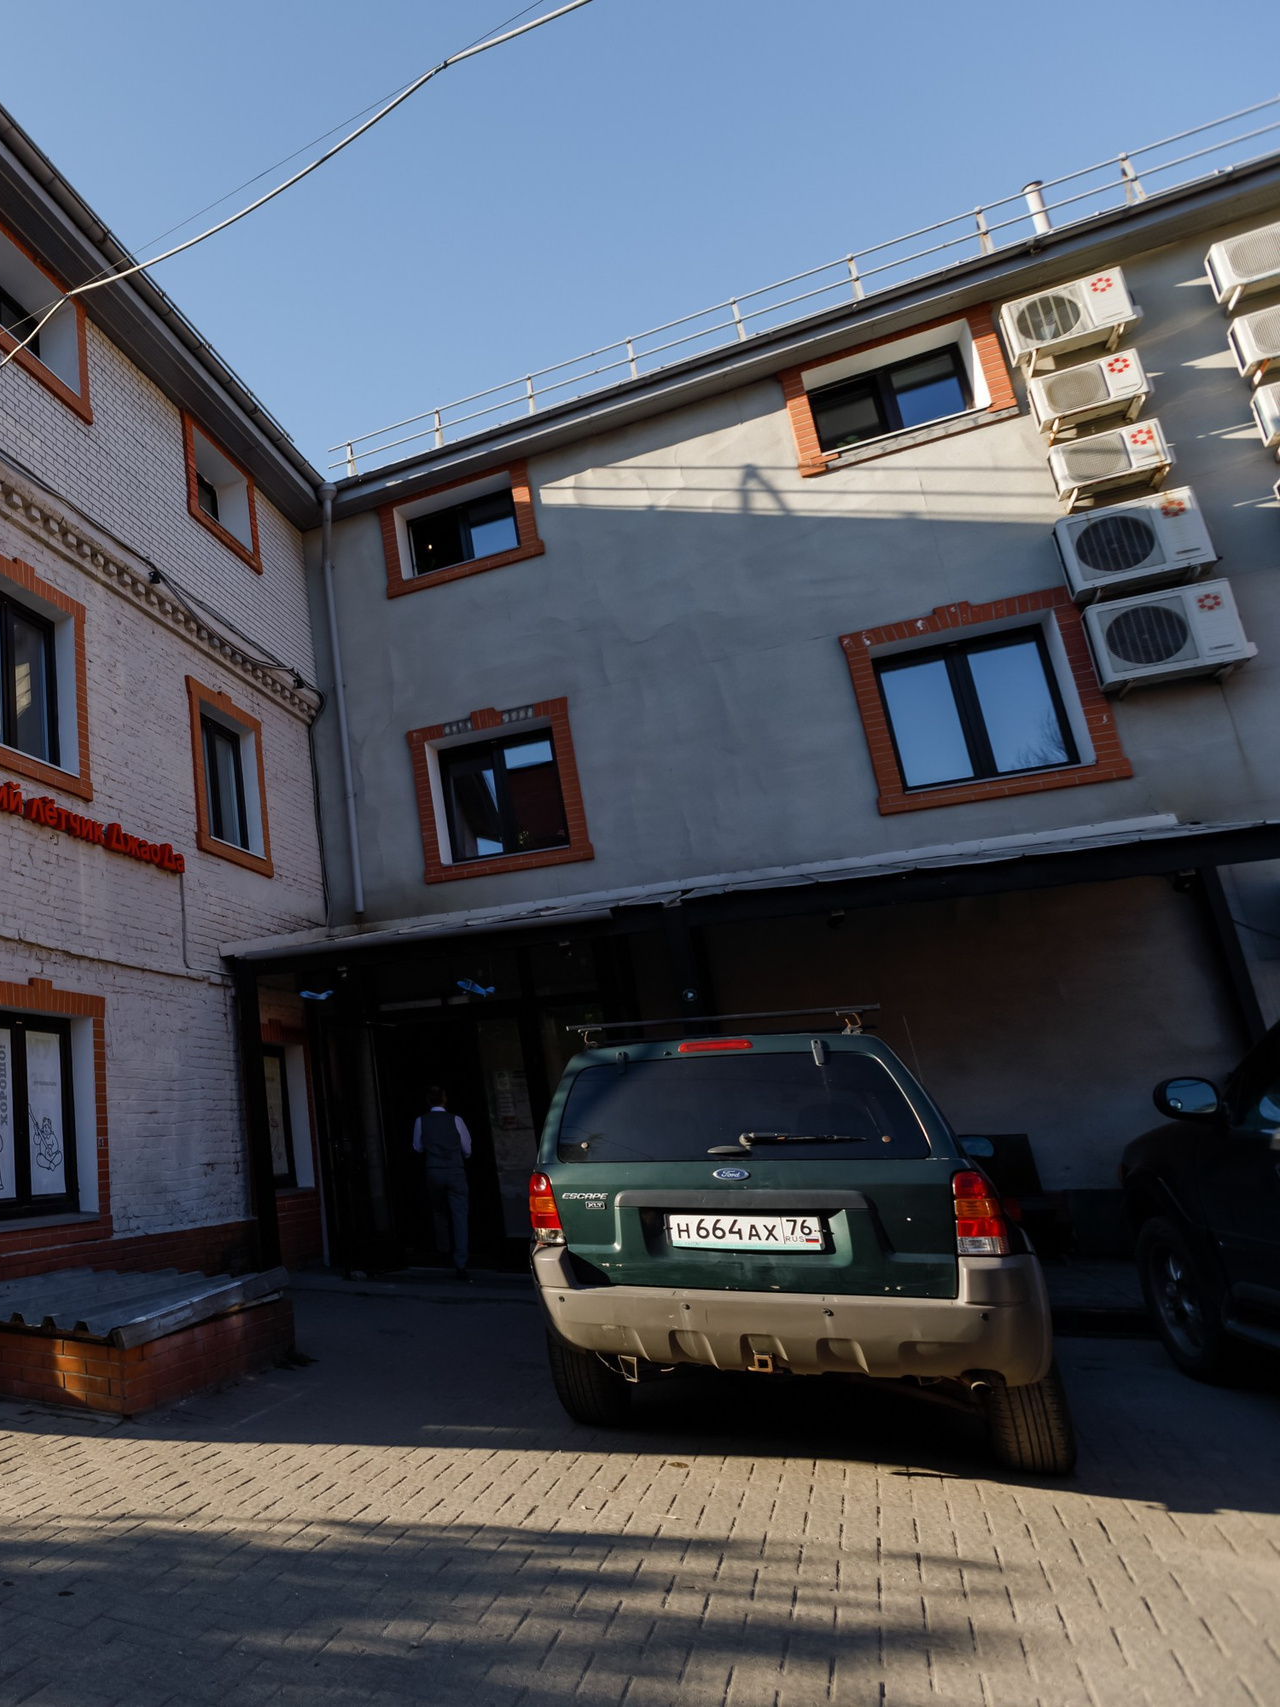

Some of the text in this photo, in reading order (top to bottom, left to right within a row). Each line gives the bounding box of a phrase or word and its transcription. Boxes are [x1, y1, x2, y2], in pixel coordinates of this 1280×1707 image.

[561, 1192, 609, 1200] ESCAPE
[785, 1218, 813, 1236] 76
[785, 1235, 805, 1243] RUS
